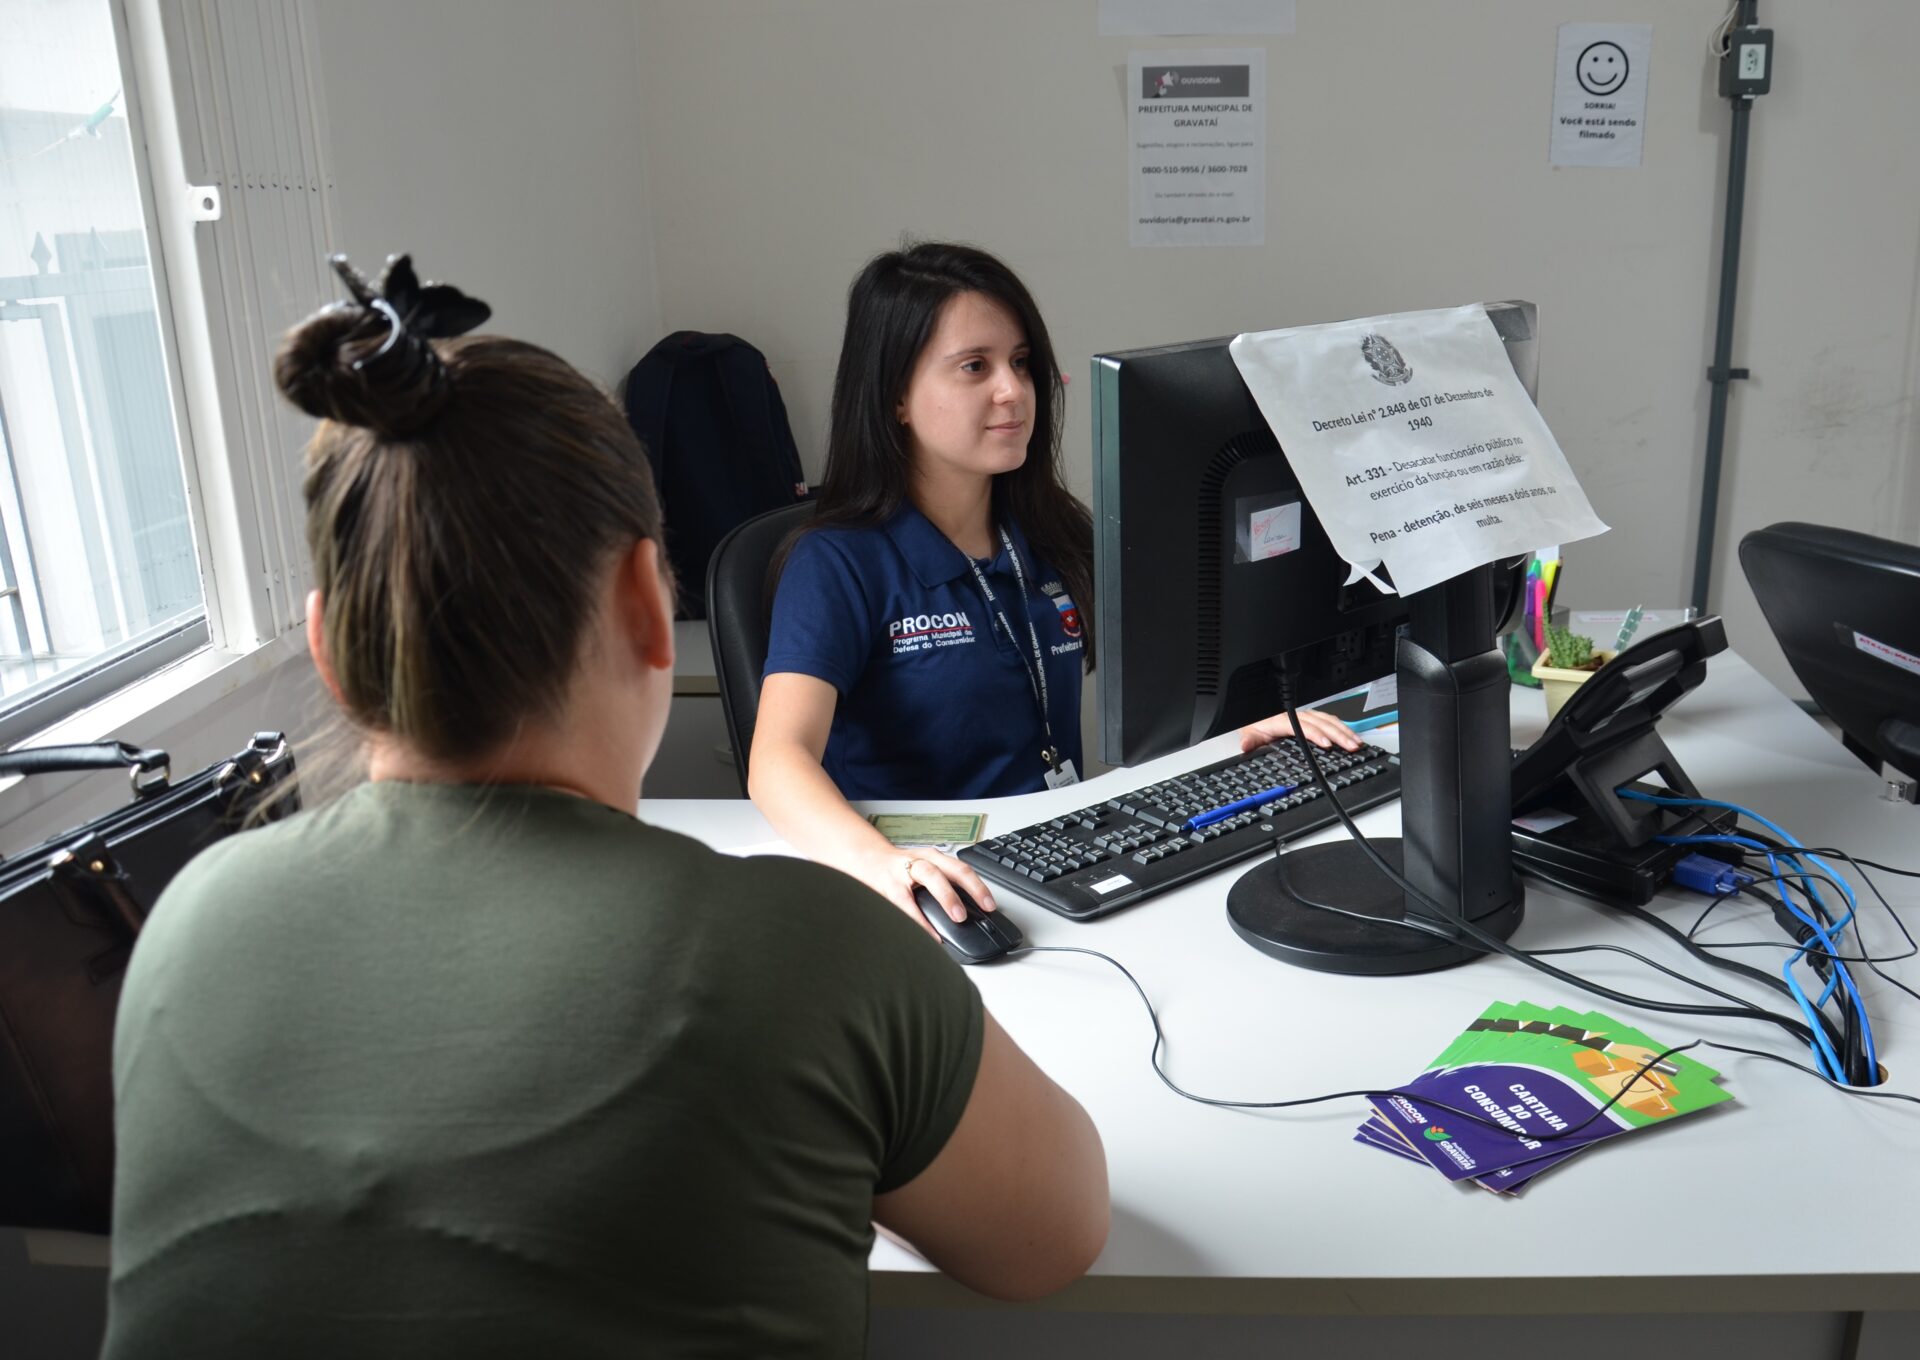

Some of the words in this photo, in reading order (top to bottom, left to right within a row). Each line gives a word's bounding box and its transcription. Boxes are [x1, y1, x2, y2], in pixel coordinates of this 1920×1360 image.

[1181, 77, 1221, 85] OUVIDORIA
[1138, 105, 1190, 113] PREFEITURA
[1192, 104, 1239, 112] MUNICIPAL
[1242, 104, 1253, 112] DE
[1174, 118, 1218, 127] GRAVATAÍ
[1560, 116, 1582, 125] Você
[1585, 117, 1605, 126] está
[1608, 118, 1637, 126] sendo
[1579, 130, 1616, 139] filmado
[1142, 165, 1200, 174] 0800-510-9956
[1208, 165, 1248, 173] 3600-7028
[1139, 216, 1251, 224] ouvidoria@gravatai.rs.gov.br
[1312, 412, 1351, 432] Decreto
[1351, 411, 1367, 424] Lei
[1379, 402, 1407, 418] 2.848
[1408, 400, 1420, 411] de
[1420, 396, 1432, 408] 07
[1434, 394, 1445, 405] de
[1445, 389, 1484, 402] Dezembro
[1484, 387, 1494, 397] de
[1408, 416, 1432, 431] 1940
[1346, 474, 1366, 487] Art.
[1365, 465, 1387, 481] 331
[1392, 456, 1437, 472] Desacatar
[1436, 443, 1485, 462] funcionário
[1485, 437, 1513, 452] público
[1514, 436, 1523, 444] no
[1370, 479, 1414, 501] exercício
[1415, 474, 1429, 486] da
[1427, 469, 1457, 482] função
[1457, 468, 1469, 476] ou
[1469, 465, 1483, 474] em
[1482, 457, 1505, 471] razão
[1369, 529, 1397, 544] Pena
[1403, 509, 1455, 533] detenção,
[1453, 503, 1467, 515] de
[1467, 498, 1484, 511] seis
[1483, 493, 1509, 507] meses
[1508, 493, 1515, 501] a
[1514, 487, 1530, 500] dois
[1530, 486, 1548, 497] anos,
[1547, 486, 1557, 494] ou
[1476, 514, 1503, 528] multa.
[889, 611, 971, 637] PROCON
[893, 634, 928, 646] Programa
[931, 629, 962, 639] Municipal
[893, 643, 919, 654] Defesa
[935, 636, 976, 647] Consumidor
[1507, 1104, 1532, 1120] DO
[1508, 1083, 1568, 1131] CARTILHA
[1440, 1140, 1477, 1170] GRAVATAÍ
